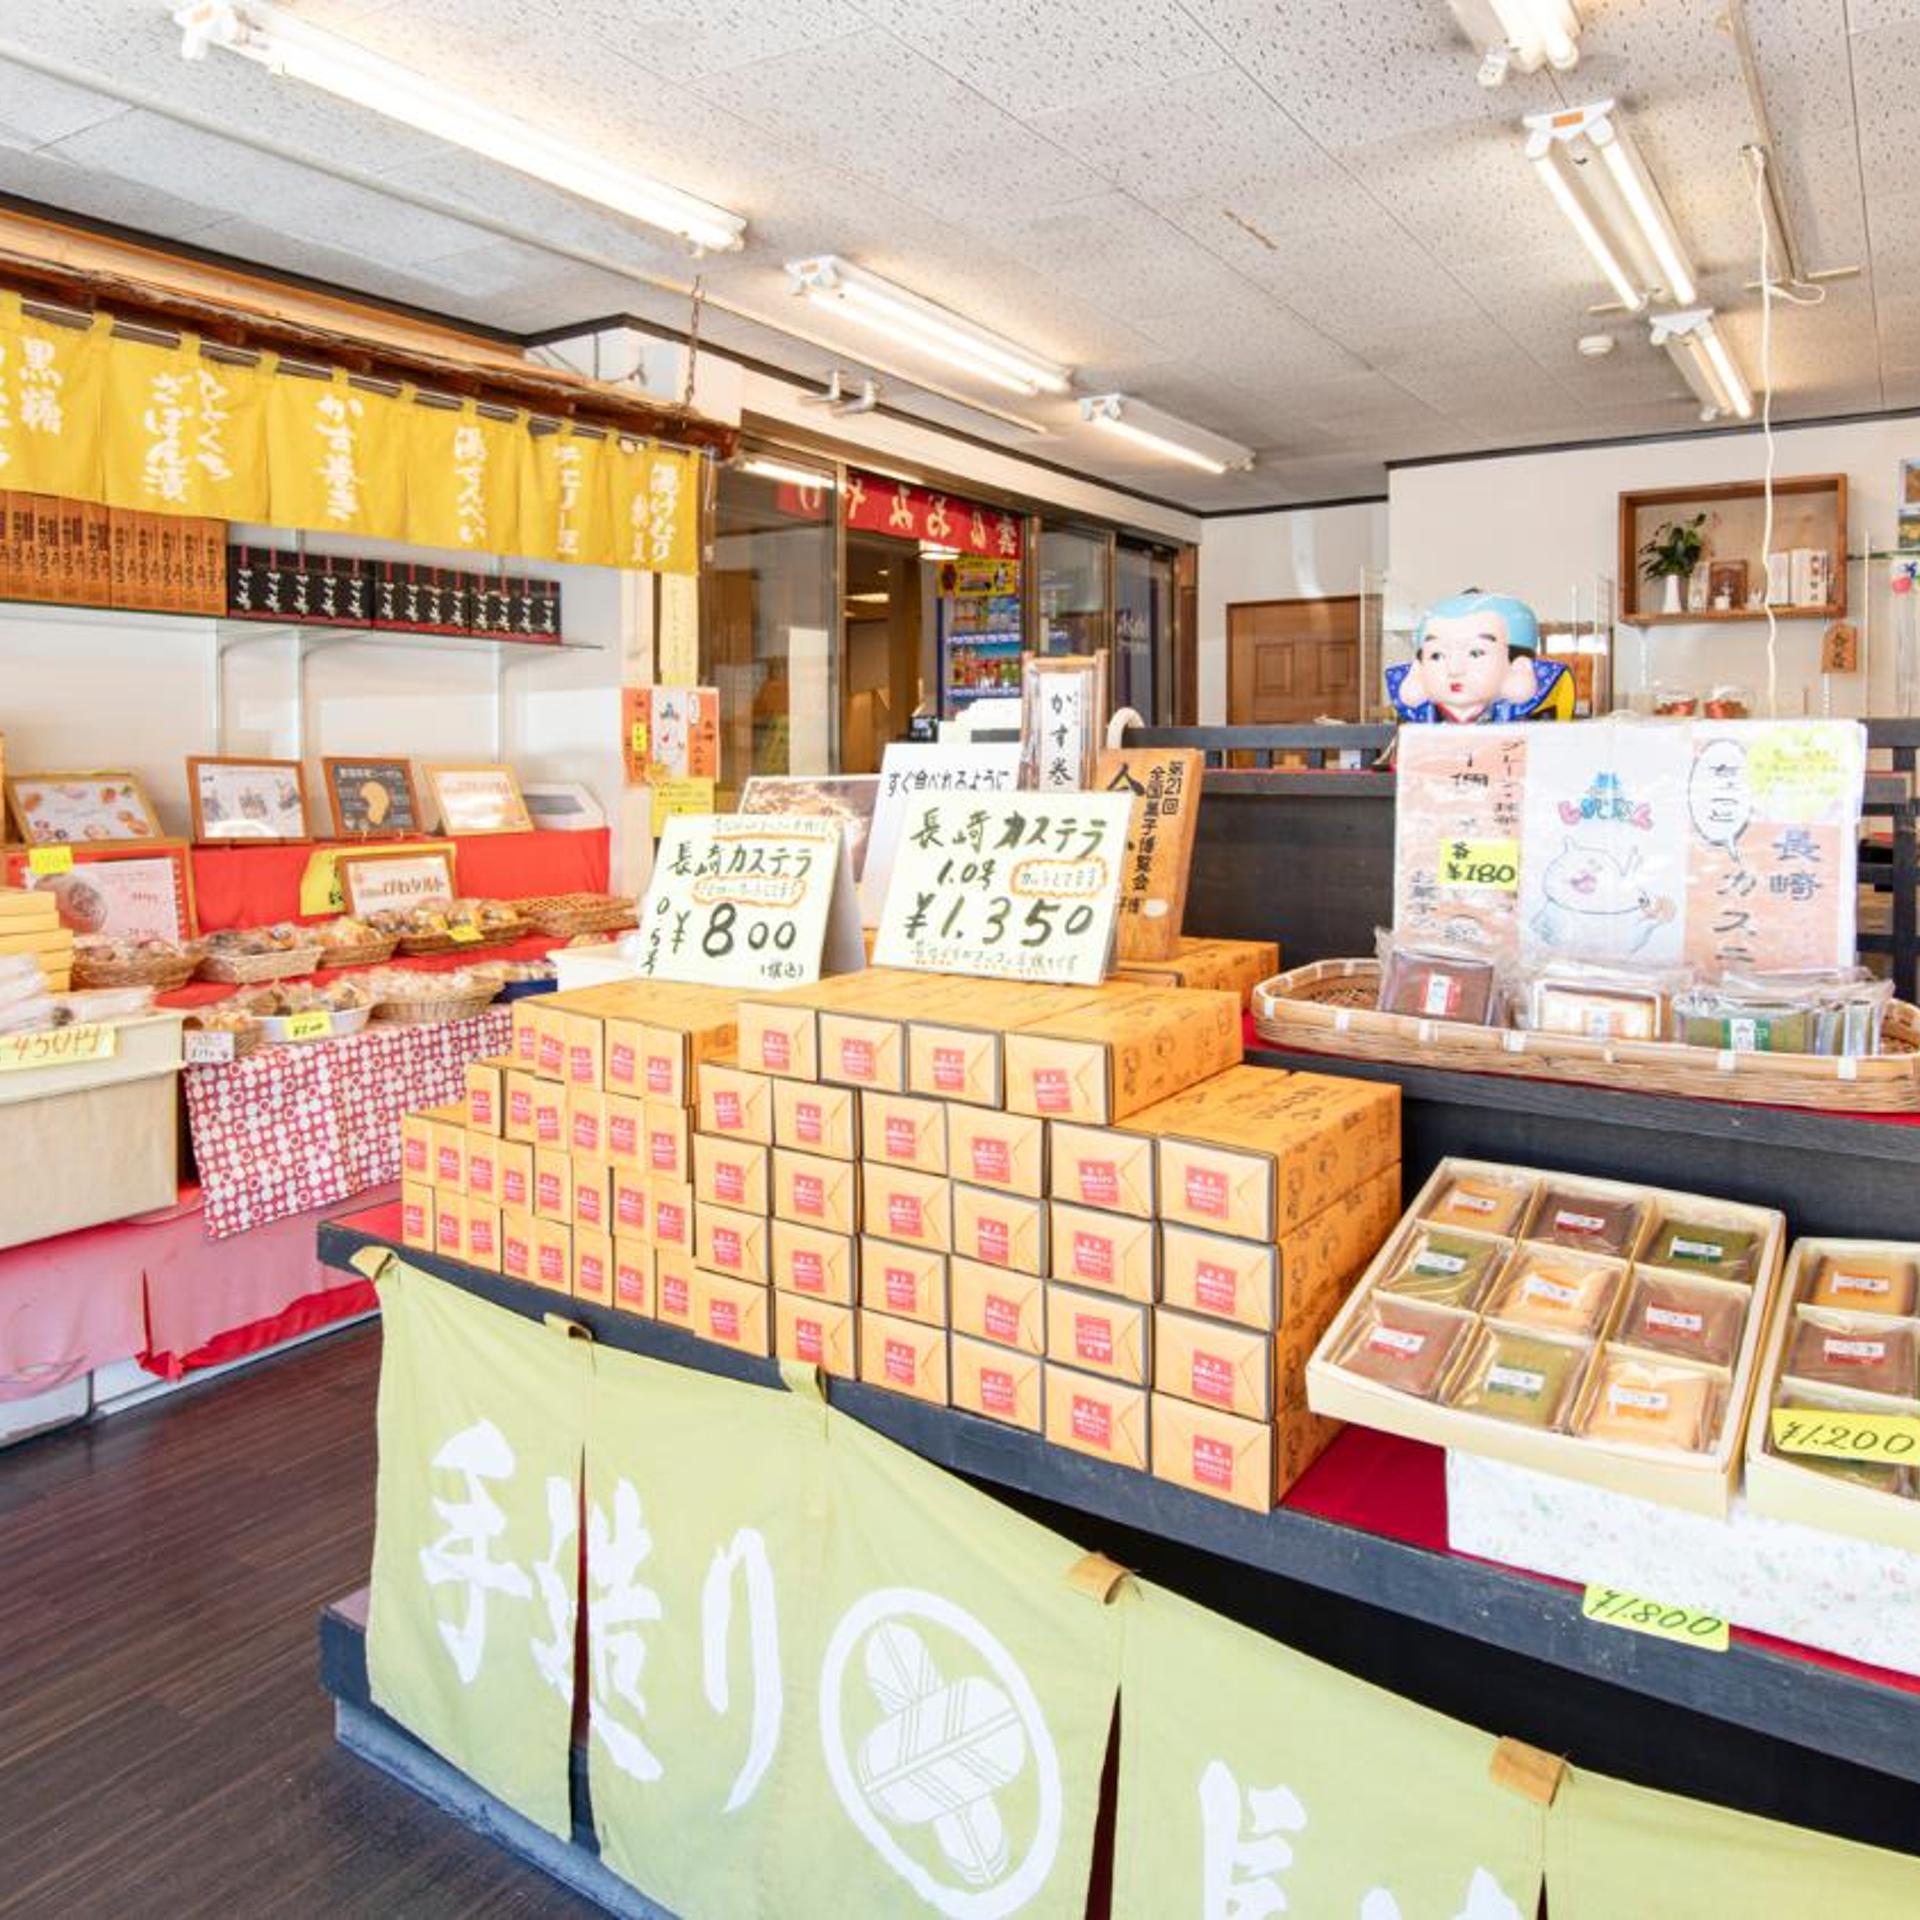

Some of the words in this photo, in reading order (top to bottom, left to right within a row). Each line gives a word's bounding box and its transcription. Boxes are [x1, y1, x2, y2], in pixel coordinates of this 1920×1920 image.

[1048, 693, 1073, 786] かす巻
[1161, 761, 1185, 816] 第21回
[667, 840, 813, 878] 長崎カステラ
[909, 807, 1108, 860] 長崎カステラ
[1769, 828, 1823, 901] 長崎
[671, 902, 797, 957] ¥800
[418, 1418, 784, 1813] 手造り
